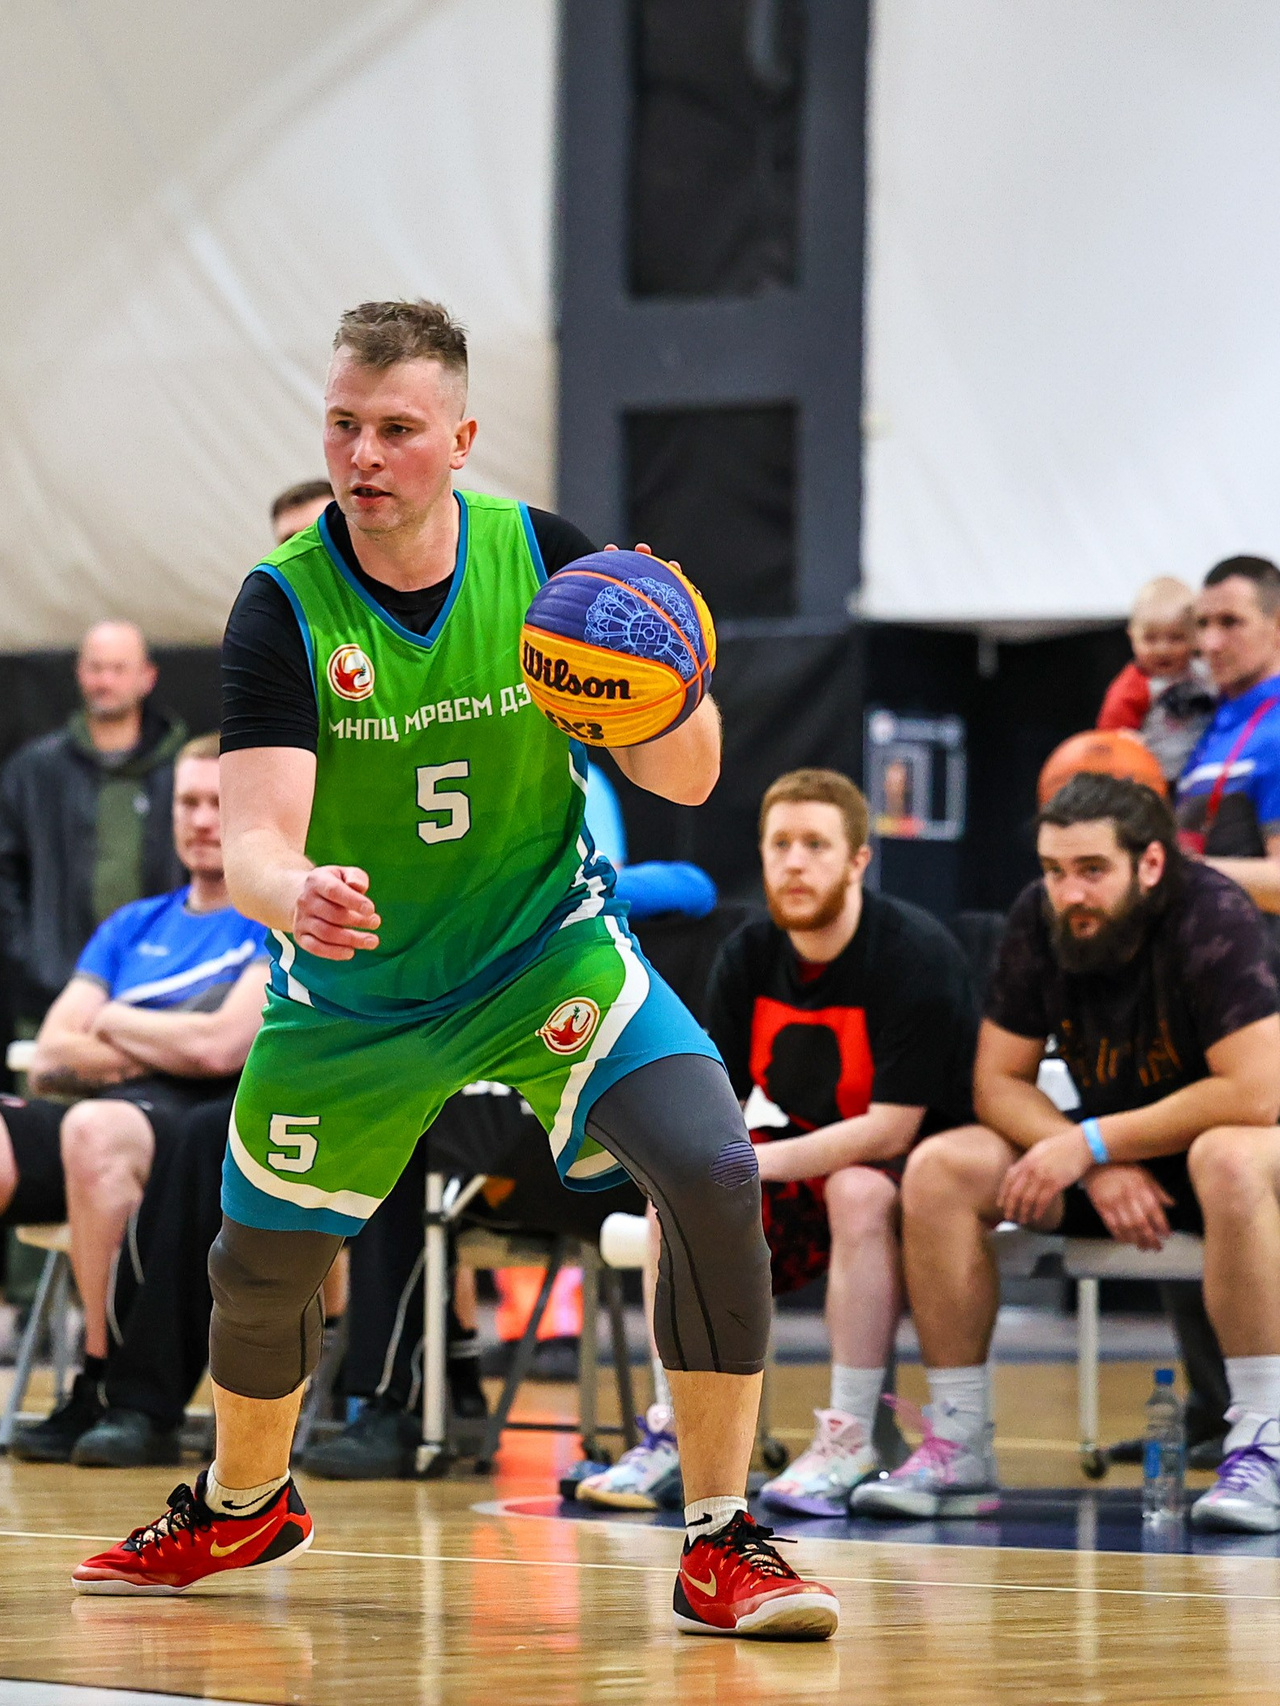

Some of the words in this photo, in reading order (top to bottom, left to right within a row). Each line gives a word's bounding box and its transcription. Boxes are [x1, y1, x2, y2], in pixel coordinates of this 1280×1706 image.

[523, 640, 631, 700] Wilson
[328, 715, 399, 742] МНПЦ
[404, 693, 493, 735] МРВСМ
[416, 758, 471, 845] 5
[266, 1111, 322, 1175] 5
